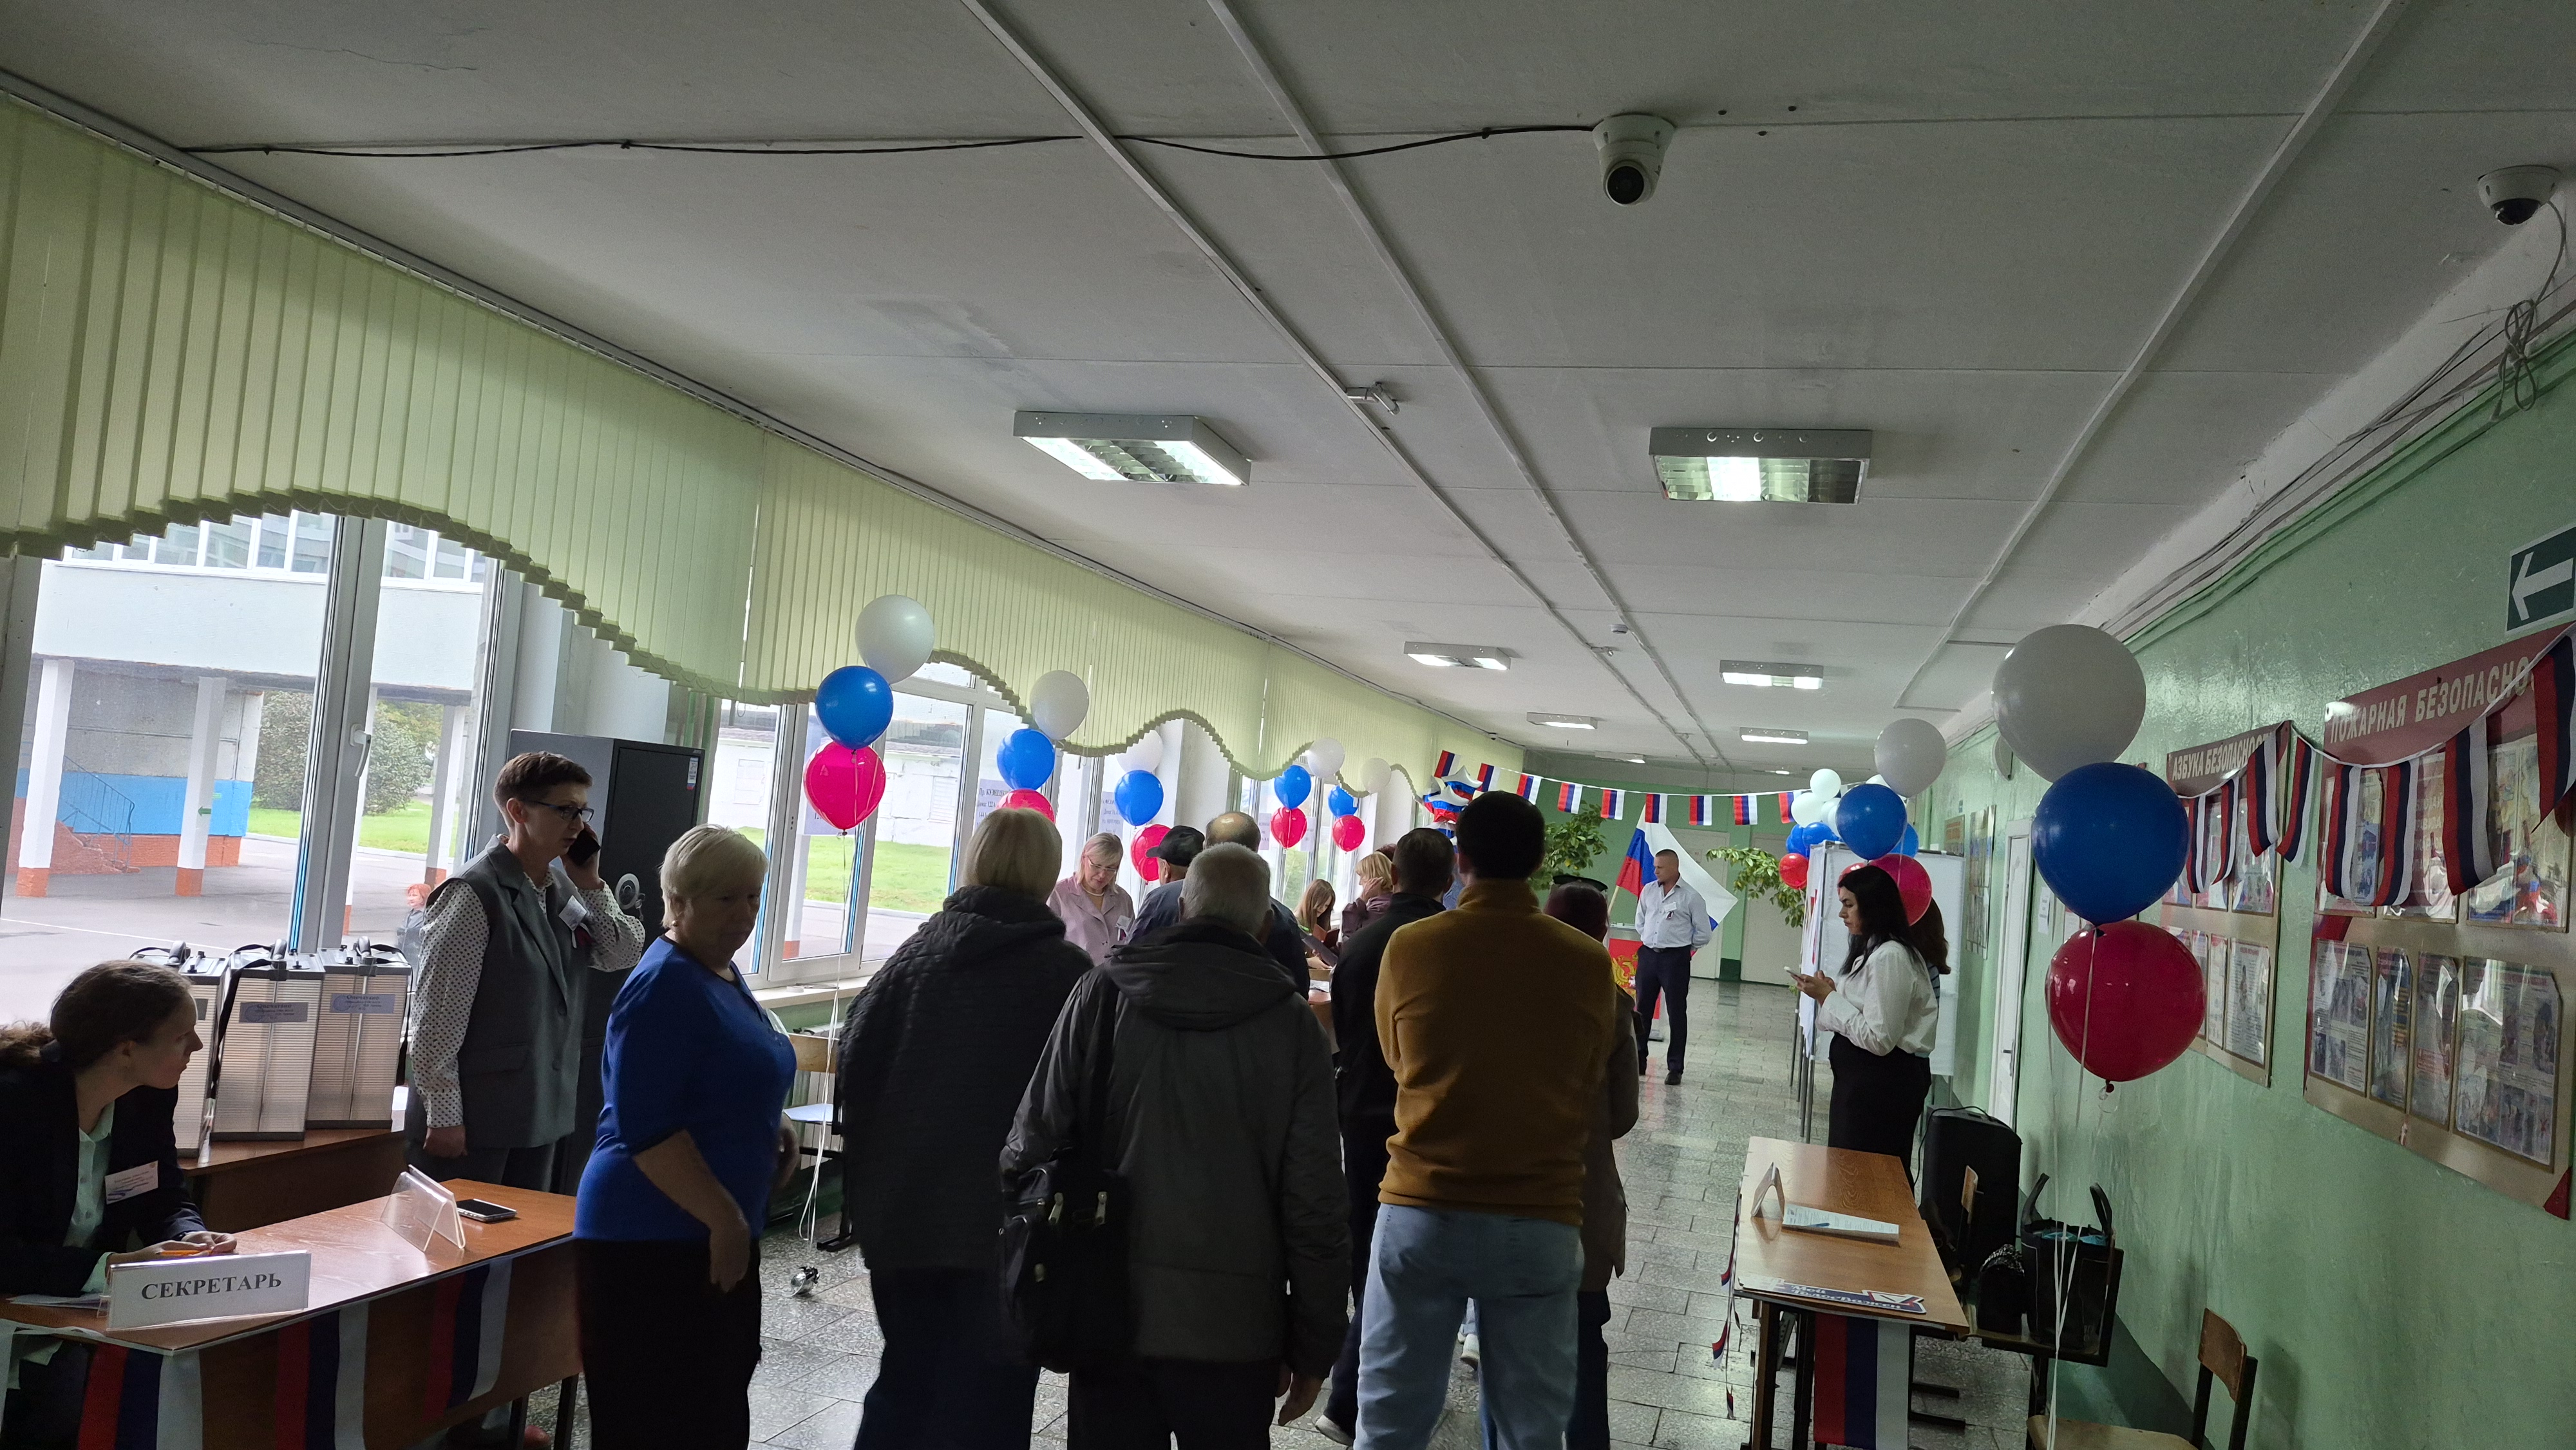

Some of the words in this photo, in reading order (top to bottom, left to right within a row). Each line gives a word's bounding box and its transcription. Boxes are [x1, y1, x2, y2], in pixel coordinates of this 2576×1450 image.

[2330, 695, 2408, 744] ПОЖАРНАЯ
[2414, 656, 2535, 722] БЕЗОПАСНО
[2172, 751, 2204, 781] АЗБУКА
[141, 1272, 282, 1300] СЕКРЕТАРЬ
